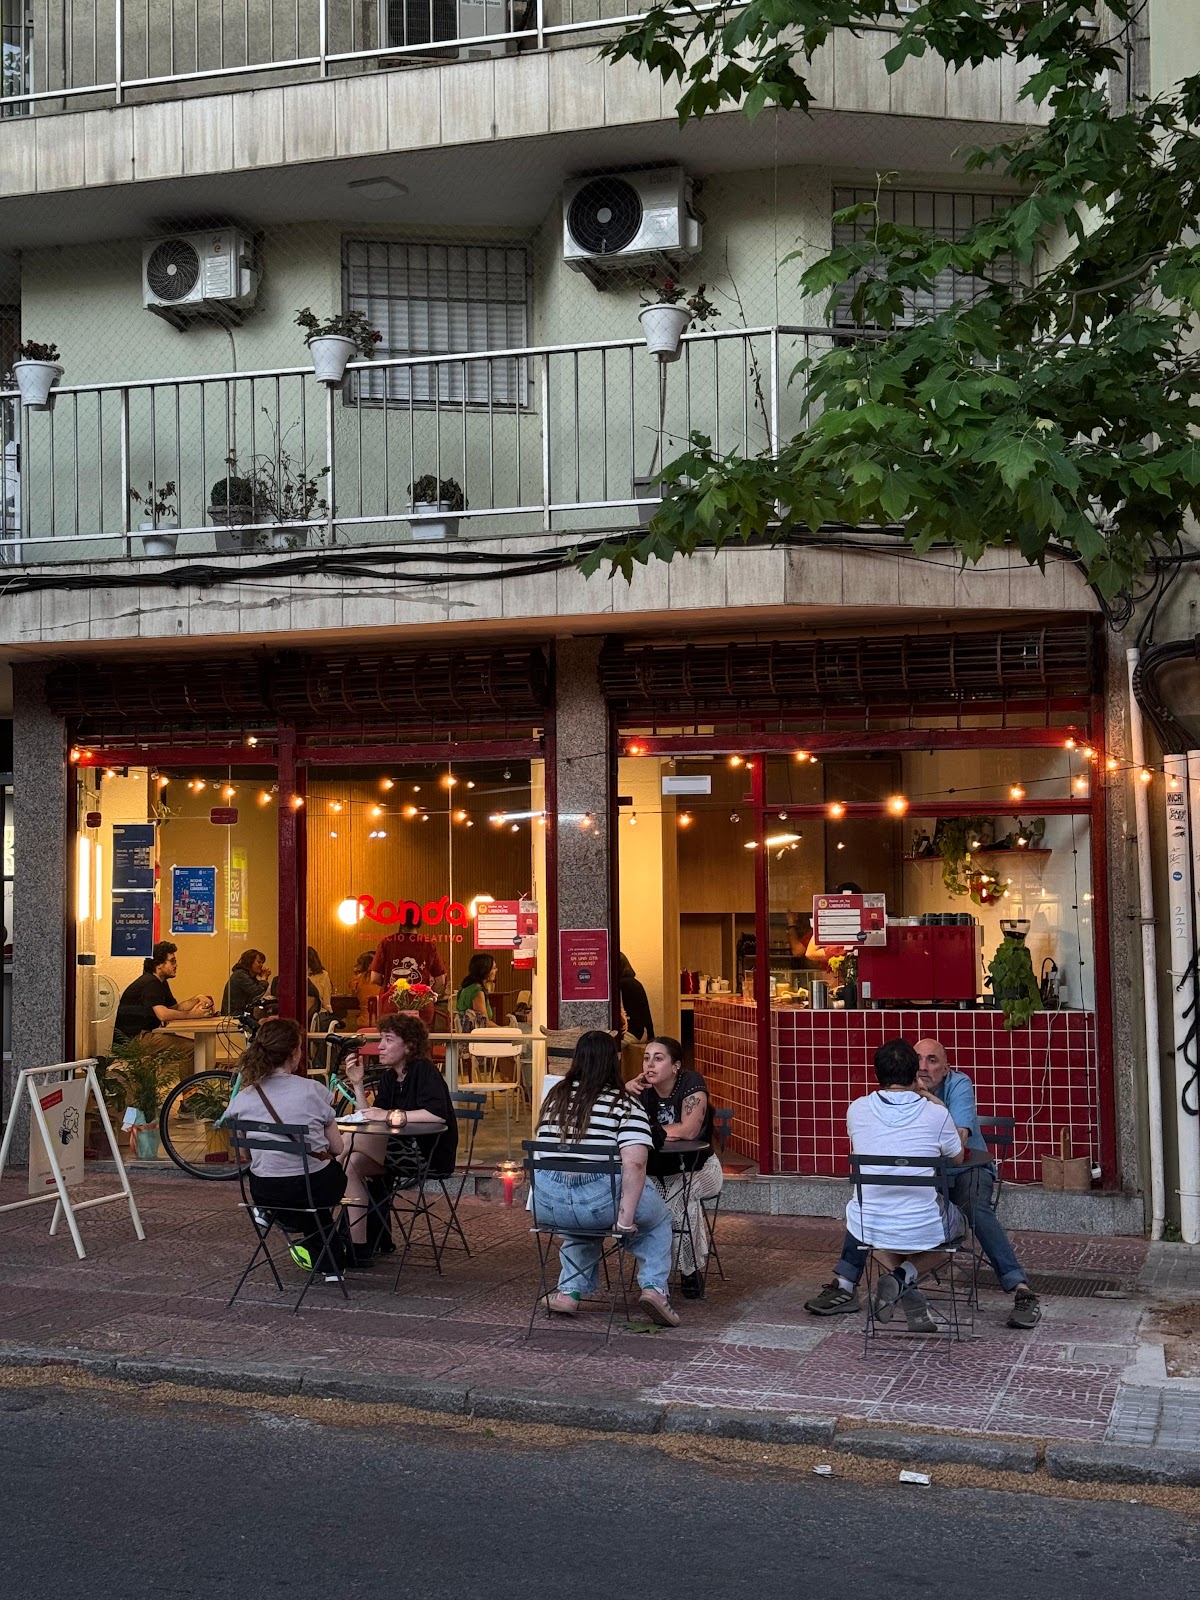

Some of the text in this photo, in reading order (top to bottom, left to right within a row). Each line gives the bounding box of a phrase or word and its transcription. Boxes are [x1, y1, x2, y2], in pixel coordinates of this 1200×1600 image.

[357, 894, 469, 929] Ronda
[360, 934, 463, 943] ESPACIO CREATIVO
